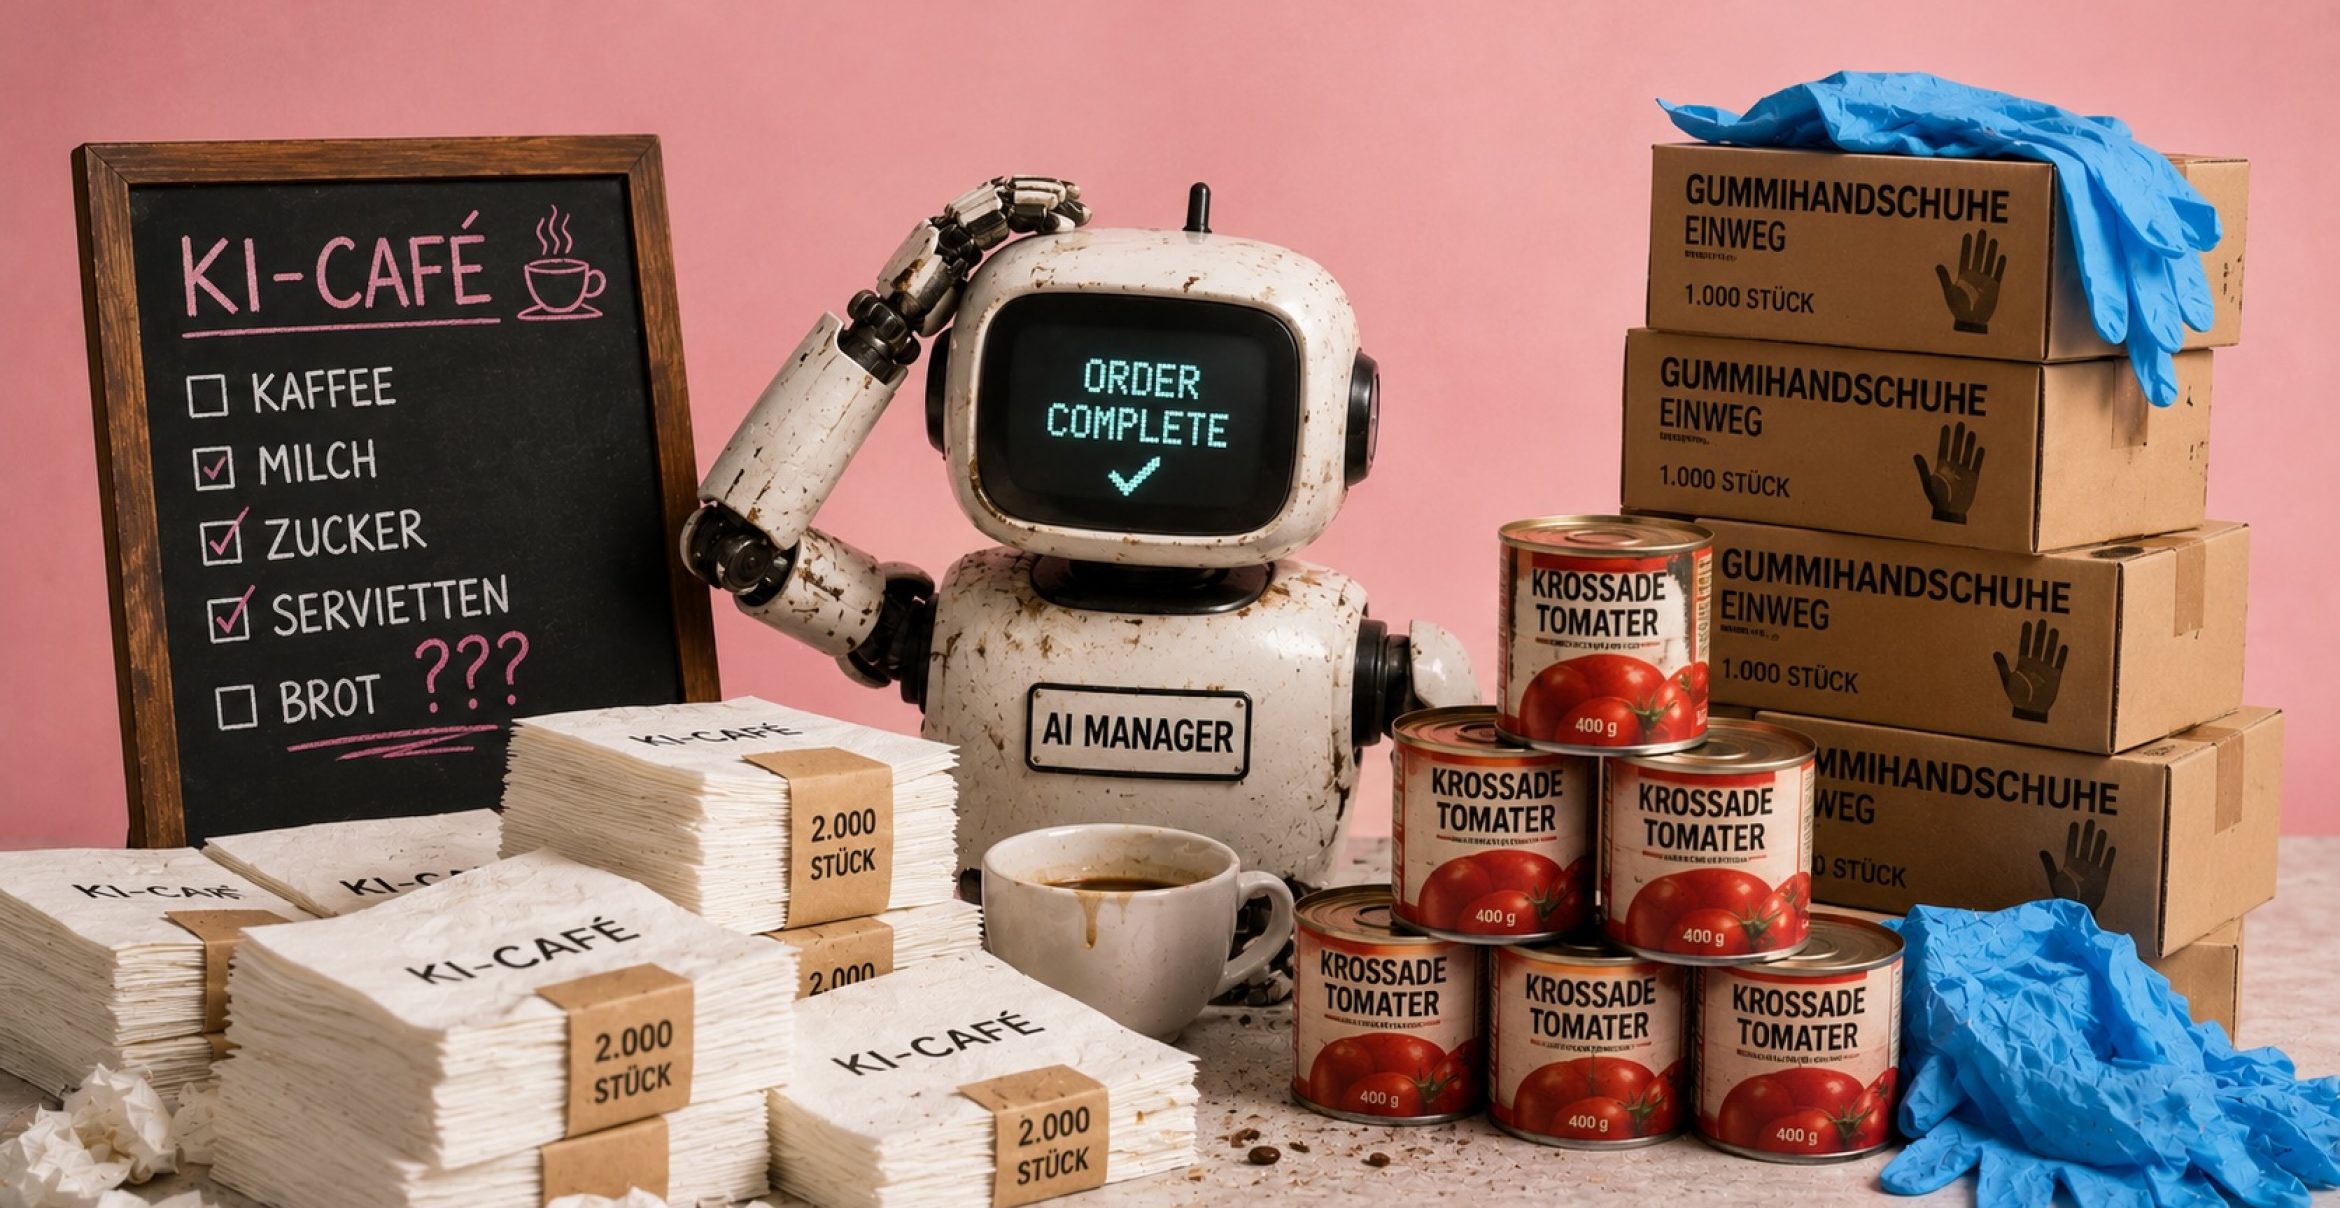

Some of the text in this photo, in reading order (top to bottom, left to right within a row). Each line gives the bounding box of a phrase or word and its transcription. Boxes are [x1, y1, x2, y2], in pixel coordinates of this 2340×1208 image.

[1686, 174, 2009, 223] GUMMIHANDSCHUHE
[1685, 215, 1785, 252] EINWEG
[182, 210, 491, 316] KI-CAFÉ
[1686, 284, 1814, 313] 1.000 STÜCK
[252, 367, 396, 413] KAFFEE
[1085, 358, 1200, 399] ORDER
[1661, 356, 1987, 417] GUMMIHANDSCHUHE
[1048, 403, 1229, 448] COMPLETE
[1660, 398, 1762, 436] EINWEG
[259, 439, 376, 485] MILCH
[1660, 465, 1790, 497] 1.000 STÜCK
[265, 509, 427, 560] ZUCKER
[1532, 569, 1666, 602] KROSSADE
[1722, 548, 2070, 614] GUMMIHANDSCHUHE
[273, 574, 509, 636] SERVIETTEN
[1536, 604, 1658, 638] TOMATER
[1721, 590, 1829, 630] EINWEG
[280, 631, 529, 723] BROT ???
[1723, 658, 1858, 693] 1.000 STÜCK
[629, 722, 802, 746] KI-CAFÉ
[1042, 713, 1233, 753] AI MANAGER
[1576, 718, 1617, 737] 400 g
[1433, 768, 1563, 800] KROSSADE
[1816, 746, 2119, 816] MMIHANDSCHUHE
[1437, 802, 1555, 832] TOMATER
[1639, 784, 1773, 817] KROSSADE
[1814, 788, 1875, 824] WEG
[812, 809, 875, 842] 2.000
[1645, 818, 1764, 851] TOMATER
[811, 847, 875, 880] STÜCK
[1833, 858, 1906, 889] STÜCK
[1476, 909, 1515, 927] 400 g
[405, 916, 640, 985] KI-CAFÉ
[1683, 928, 1724, 947] 400 g
[1321, 949, 1447, 985] KROSSADE
[1324, 983, 1439, 1017] TOMATER
[1526, 973, 1656, 1008] KROSSADE
[1732, 984, 1866, 1018] KROSSADE
[595, 1020, 672, 1062] 2.000
[1530, 1007, 1648, 1041] TOMATER
[1737, 1018, 1858, 1051] TOMATER
[832, 1011, 1045, 1075] KI-CAFÉ
[595, 1062, 671, 1104] STÜCK
[1360, 1090, 1398, 1108] 400 g
[1019, 1107, 1089, 1146] 2.000
[1569, 1115, 1608, 1132] 400 g
[1777, 1128, 1817, 1145] 400 g
[1017, 1147, 1089, 1185] STÜCK
